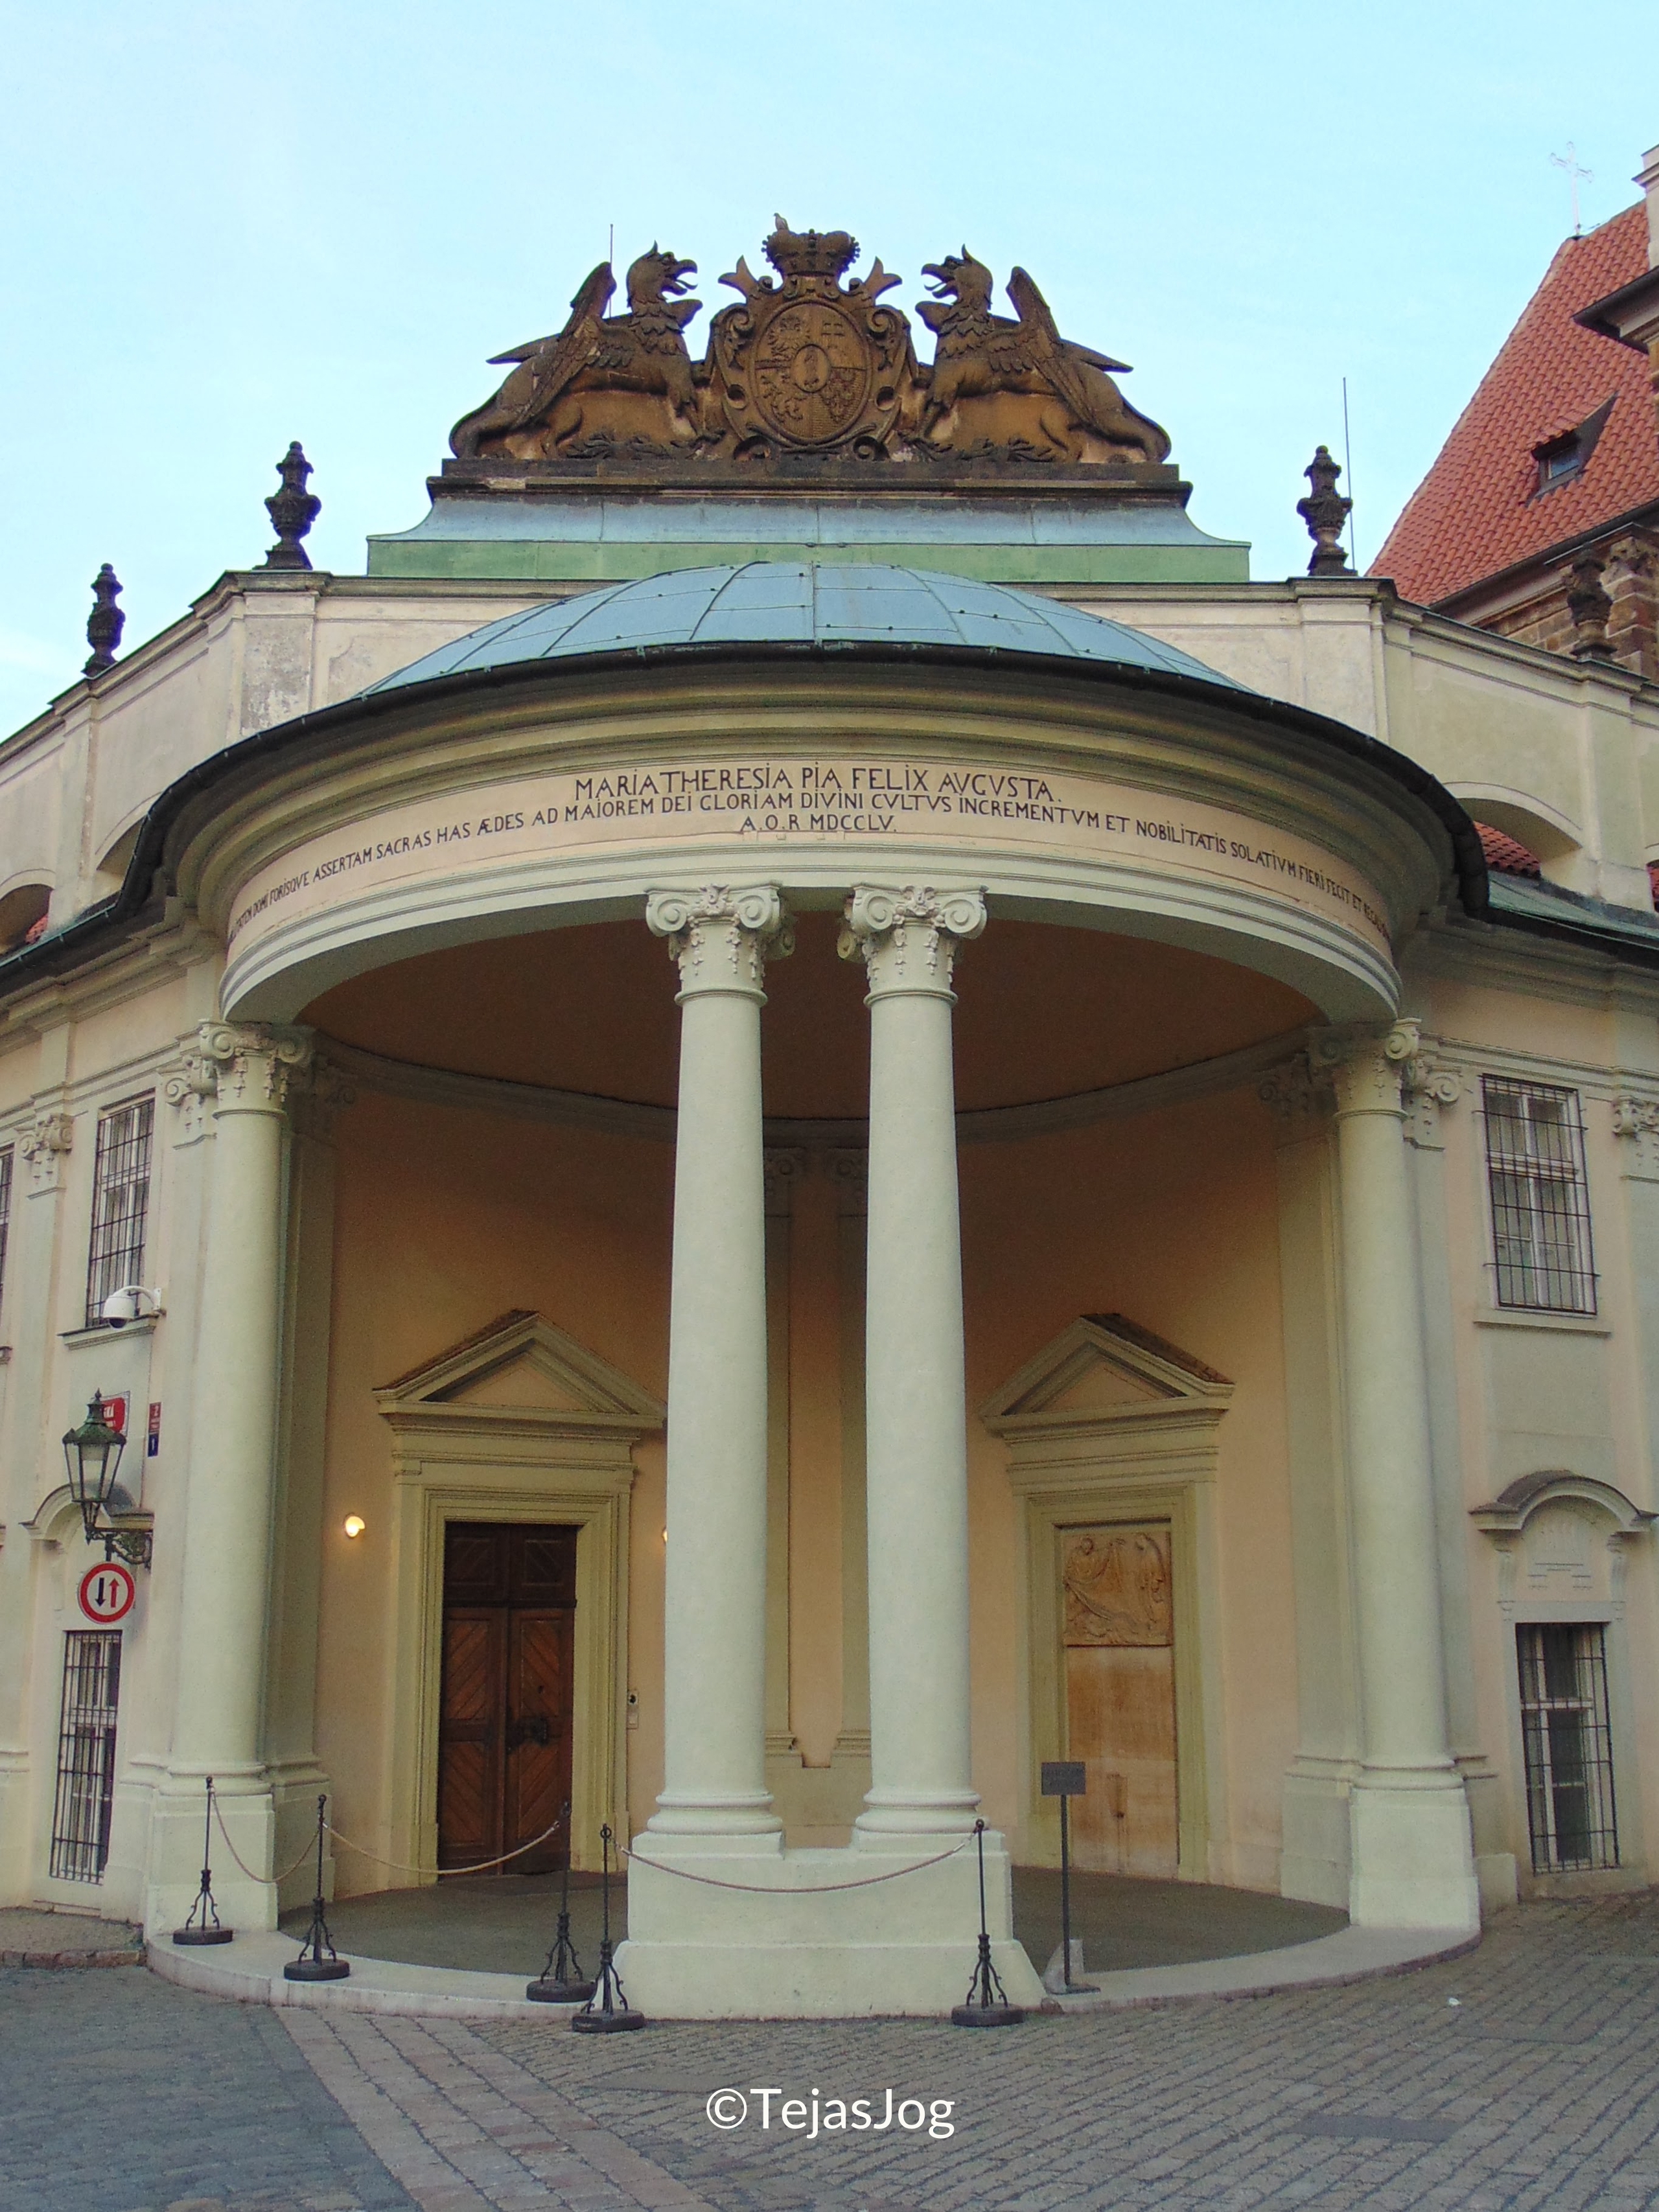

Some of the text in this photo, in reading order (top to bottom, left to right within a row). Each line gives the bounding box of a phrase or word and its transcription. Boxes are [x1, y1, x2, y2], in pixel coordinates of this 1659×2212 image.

[575, 768, 659, 800] MARIA
[660, 763, 793, 793] THERESIA
[802, 761, 842, 789] PIA
[852, 765, 929, 792] FELIX
[312, 847, 372, 882] ASSERTAM
[377, 831, 432, 859] SACRAS
[437, 823, 470, 844] HAS
[477, 812, 524, 836] ÆDES
[531, 807, 558, 827] AD
[565, 798, 655, 822] MAIOREM
[662, 792, 691, 813] DEI
[700, 790, 793, 811] GLORIAM
[801, 789, 863, 809] DIVINI
[872, 793, 952, 812] CVLTVS
[958, 792, 1100, 829] INCREMENTVM
[1106, 814, 1130, 833] ET
[1136, 820, 1227, 854] NOBILITATIS
[1231, 842, 1296, 877] SOLATIVM
